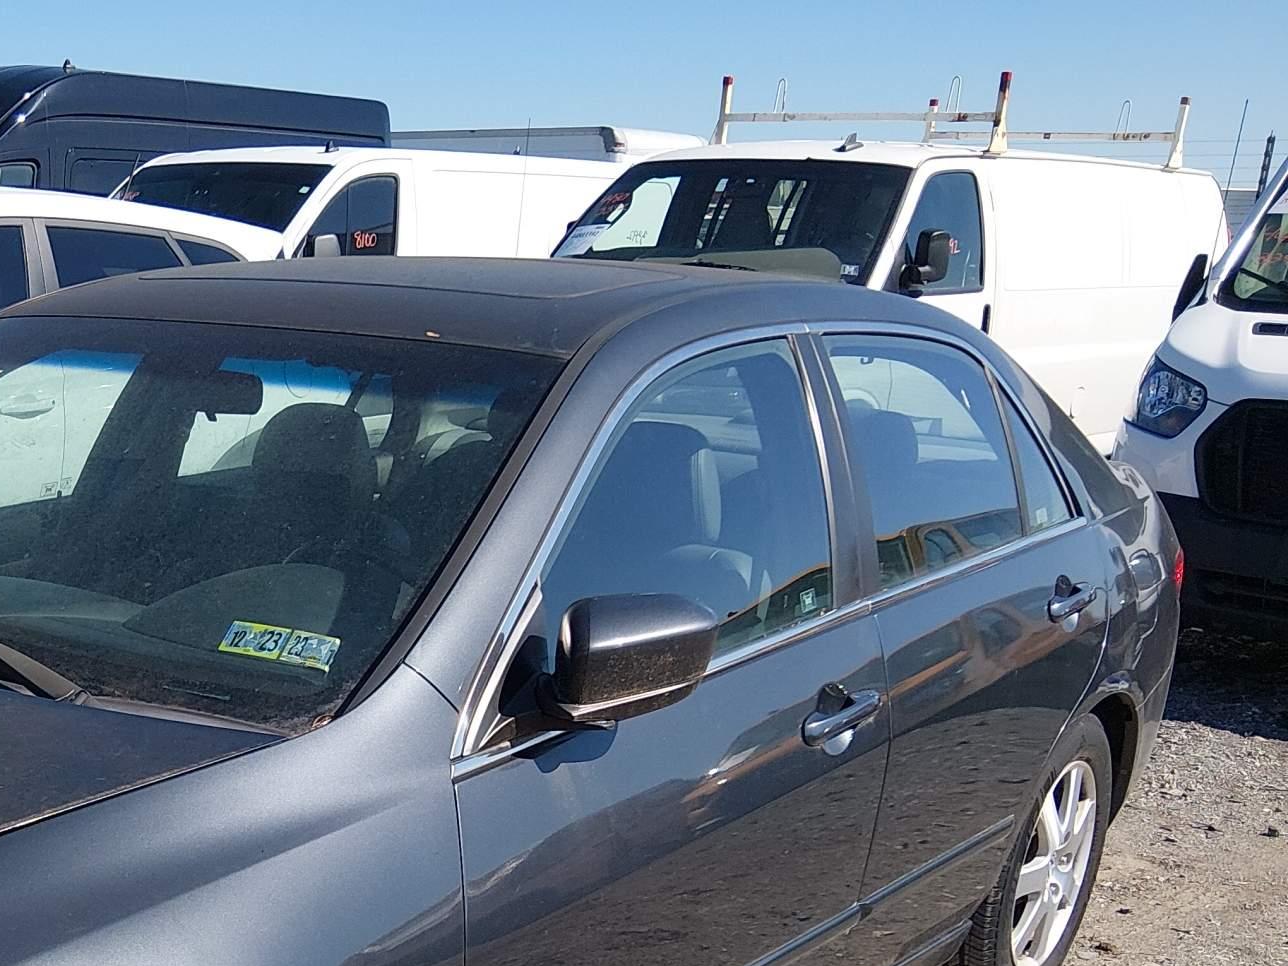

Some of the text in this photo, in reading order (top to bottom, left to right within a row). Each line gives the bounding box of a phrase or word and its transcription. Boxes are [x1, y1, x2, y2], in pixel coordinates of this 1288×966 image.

[353, 230, 378, 249] 8100
[228, 630, 283, 652] 12 23
[287, 634, 309, 657] 23
